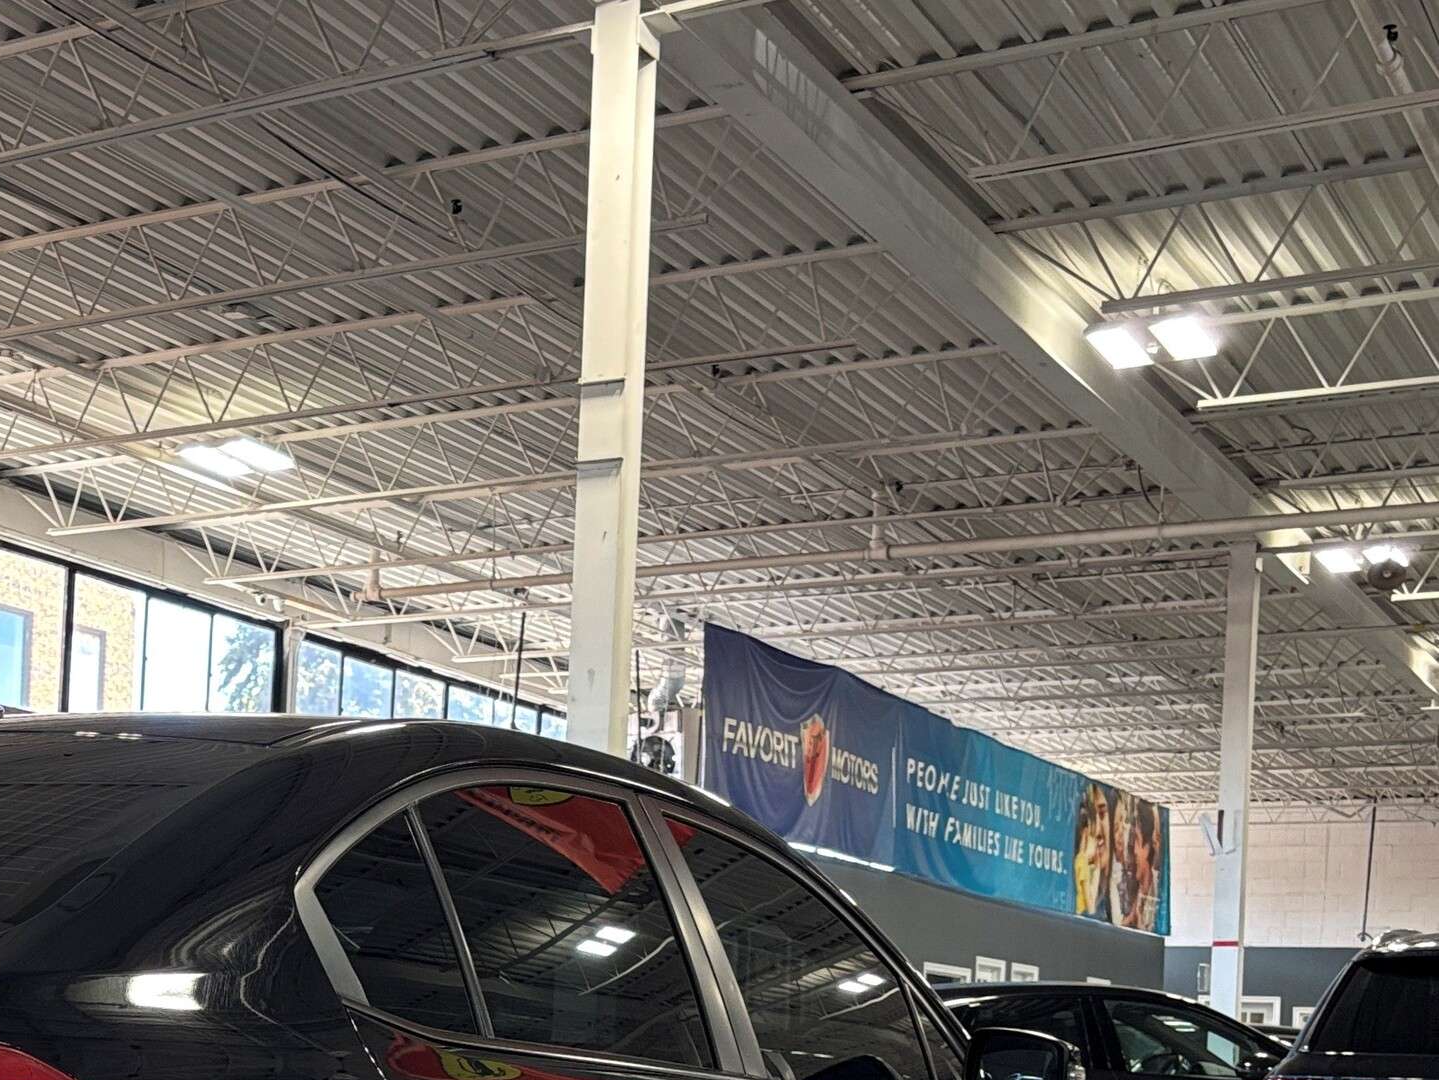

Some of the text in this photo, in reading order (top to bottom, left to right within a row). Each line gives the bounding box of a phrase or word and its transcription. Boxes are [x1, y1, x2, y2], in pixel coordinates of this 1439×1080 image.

[722, 717, 878, 794] FAVORIT MOTORS
[962, 780, 990, 811] JUST
[994, 790, 1018, 820] LIKE
[906, 803, 939, 838] WITH
[944, 817, 1000, 856] FAMILIES
[1004, 835, 1024, 864] LIKE
